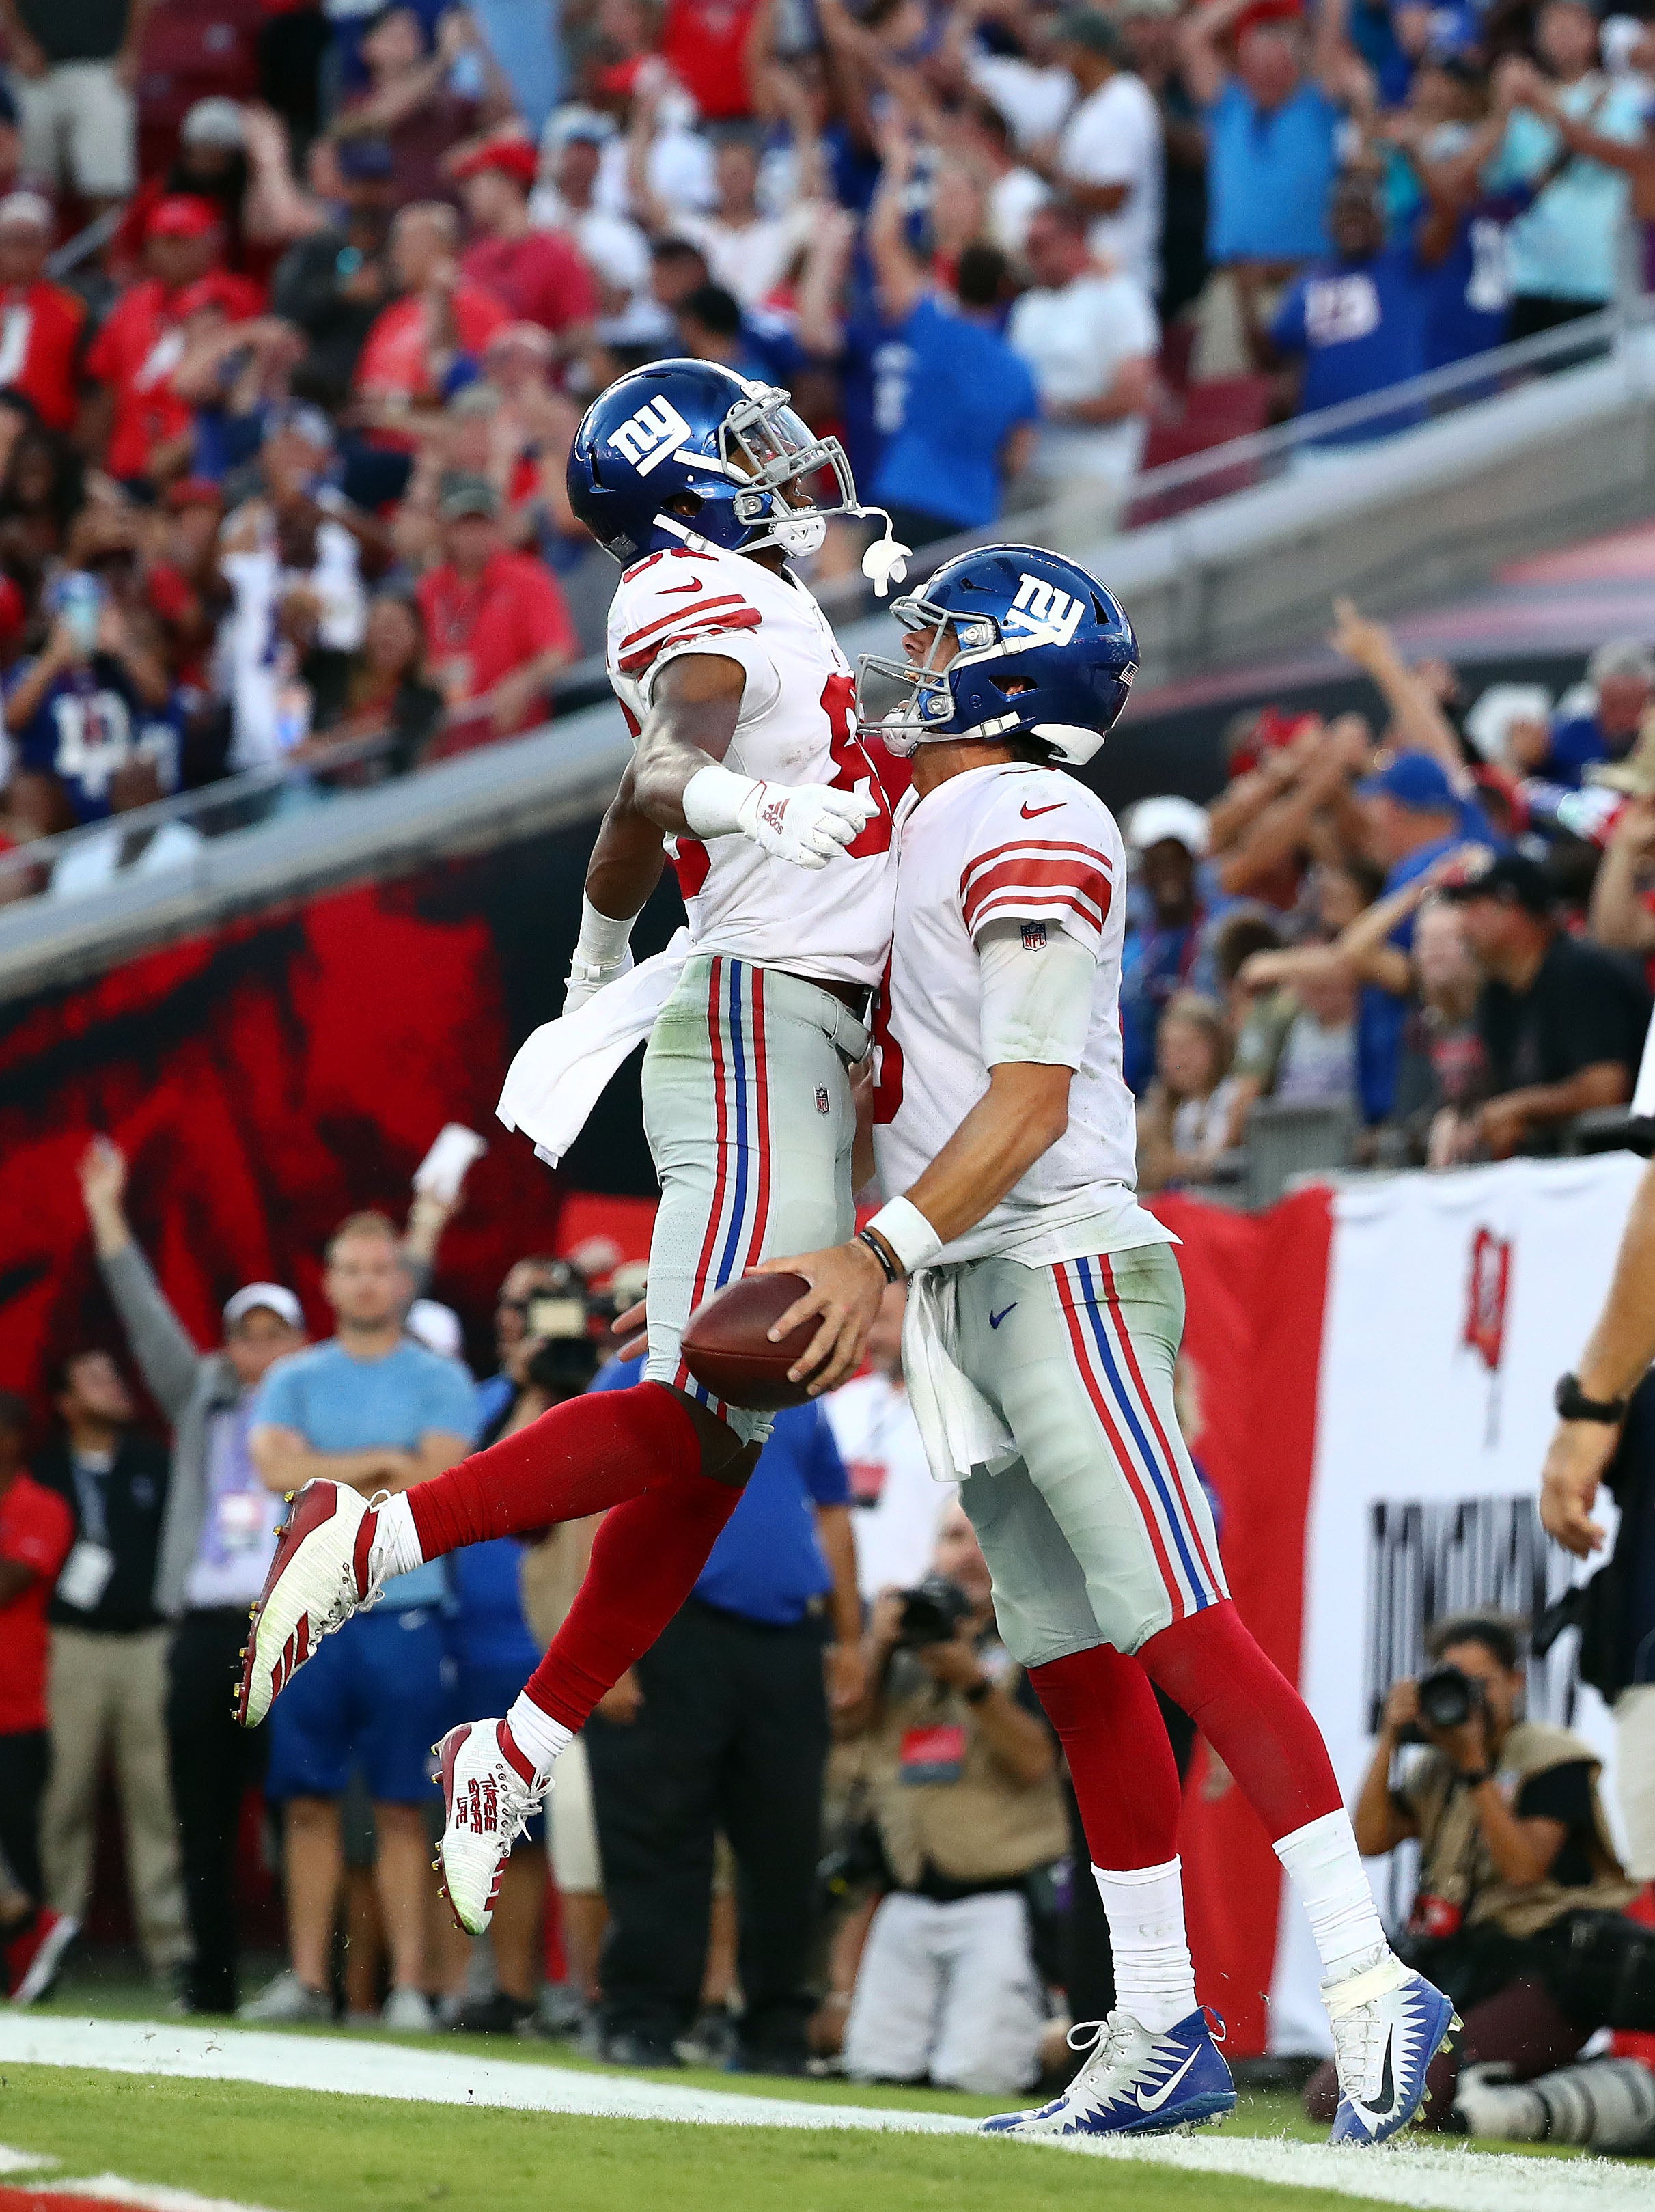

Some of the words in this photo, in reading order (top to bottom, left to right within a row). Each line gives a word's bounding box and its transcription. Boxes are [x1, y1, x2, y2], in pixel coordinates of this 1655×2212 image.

[761, 810, 784, 835] adidas
[1024, 933, 1045, 948] NFL
[456, 1797, 468, 1829] LIFE
[468, 1778, 483, 1834] STRIPE
[480, 1773, 499, 1832] THREE
